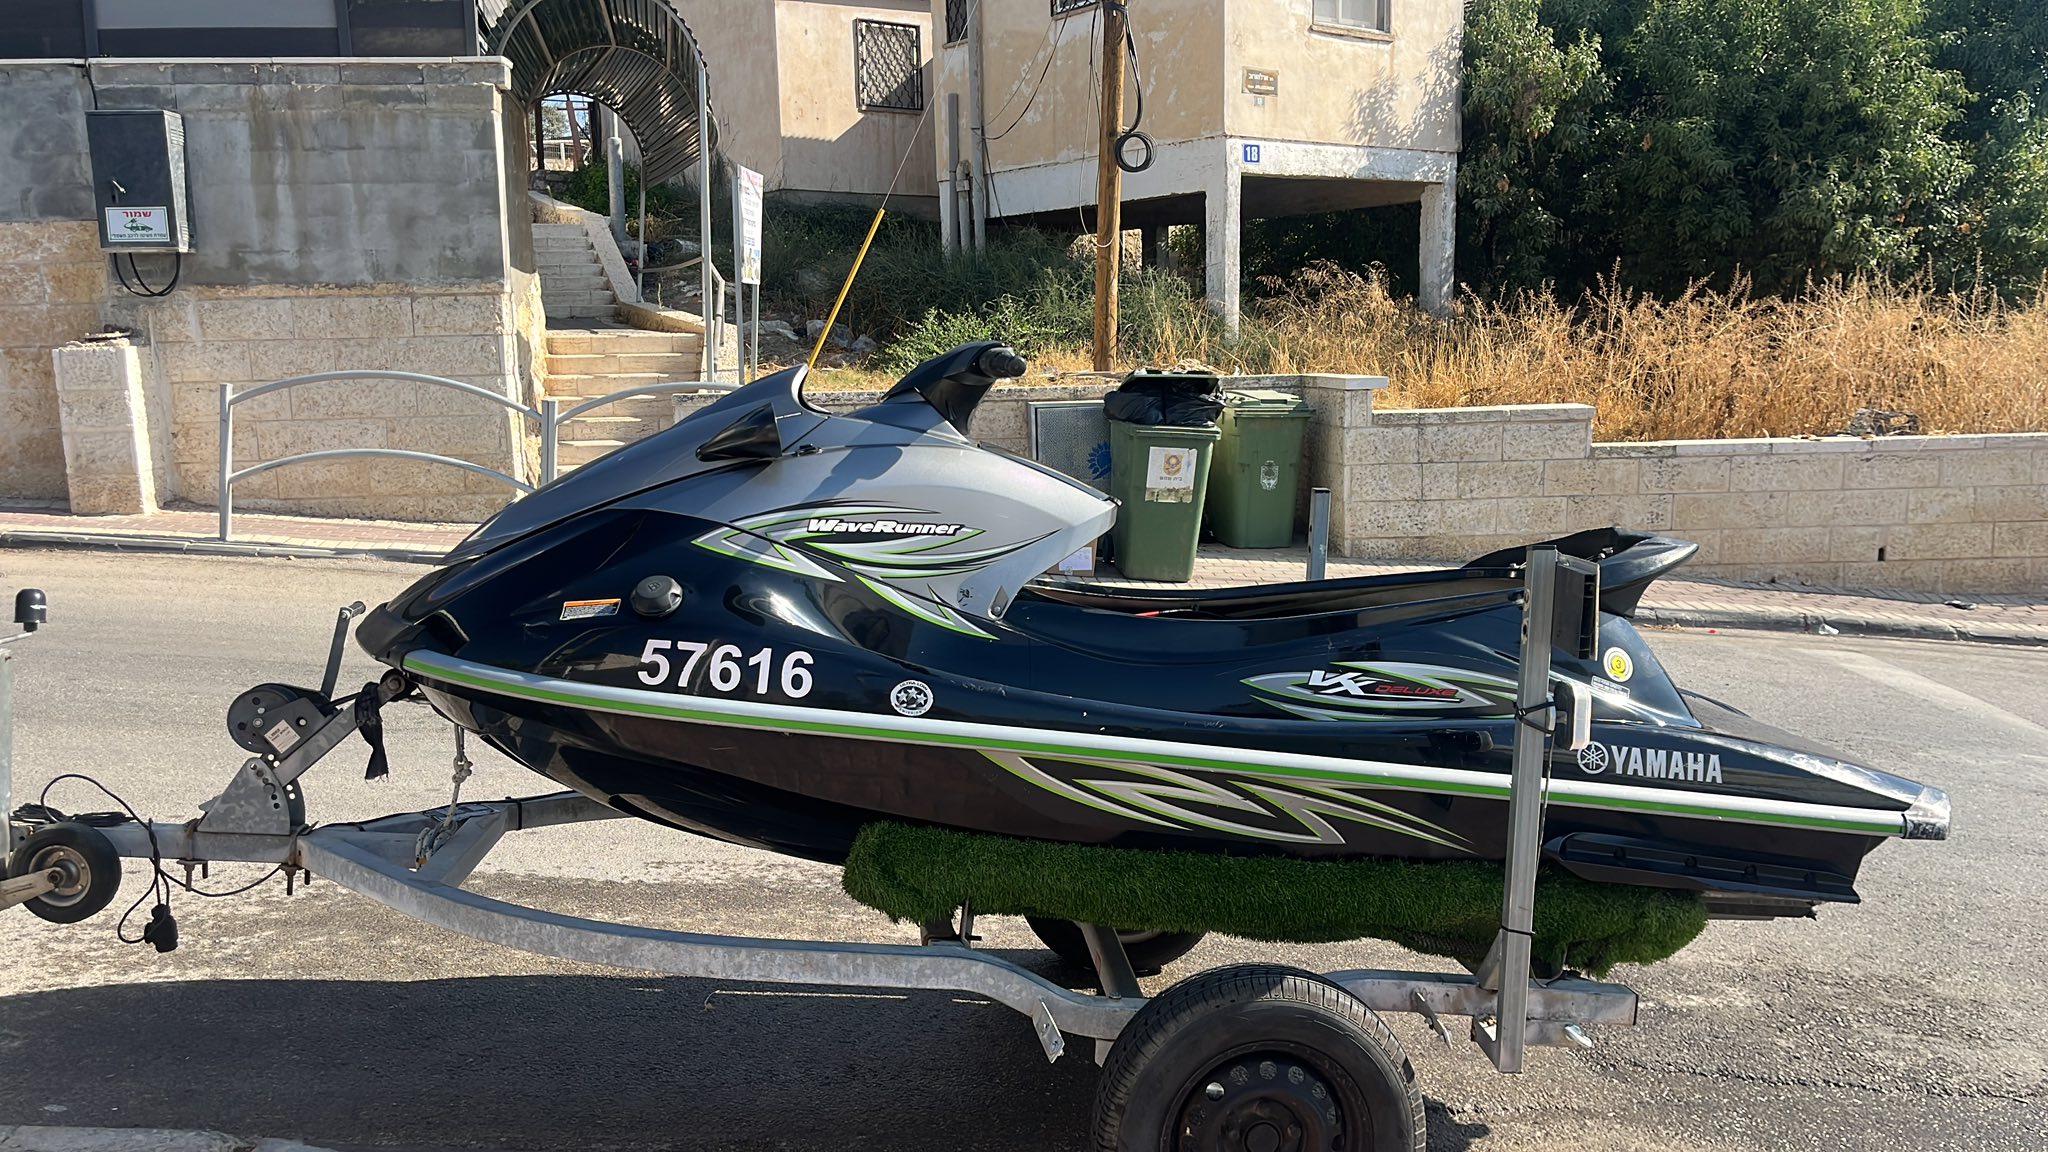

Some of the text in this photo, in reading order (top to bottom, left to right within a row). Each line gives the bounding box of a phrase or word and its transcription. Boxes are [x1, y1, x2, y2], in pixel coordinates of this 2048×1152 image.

[1246, 146, 1258, 161] 18
[808, 518, 960, 535] WaveRunner
[638, 639, 814, 698] 57616
[1615, 659, 1622, 669] 3
[1308, 669, 1458, 697] VX DELUXE
[1611, 744, 1723, 784] YAMAHA
